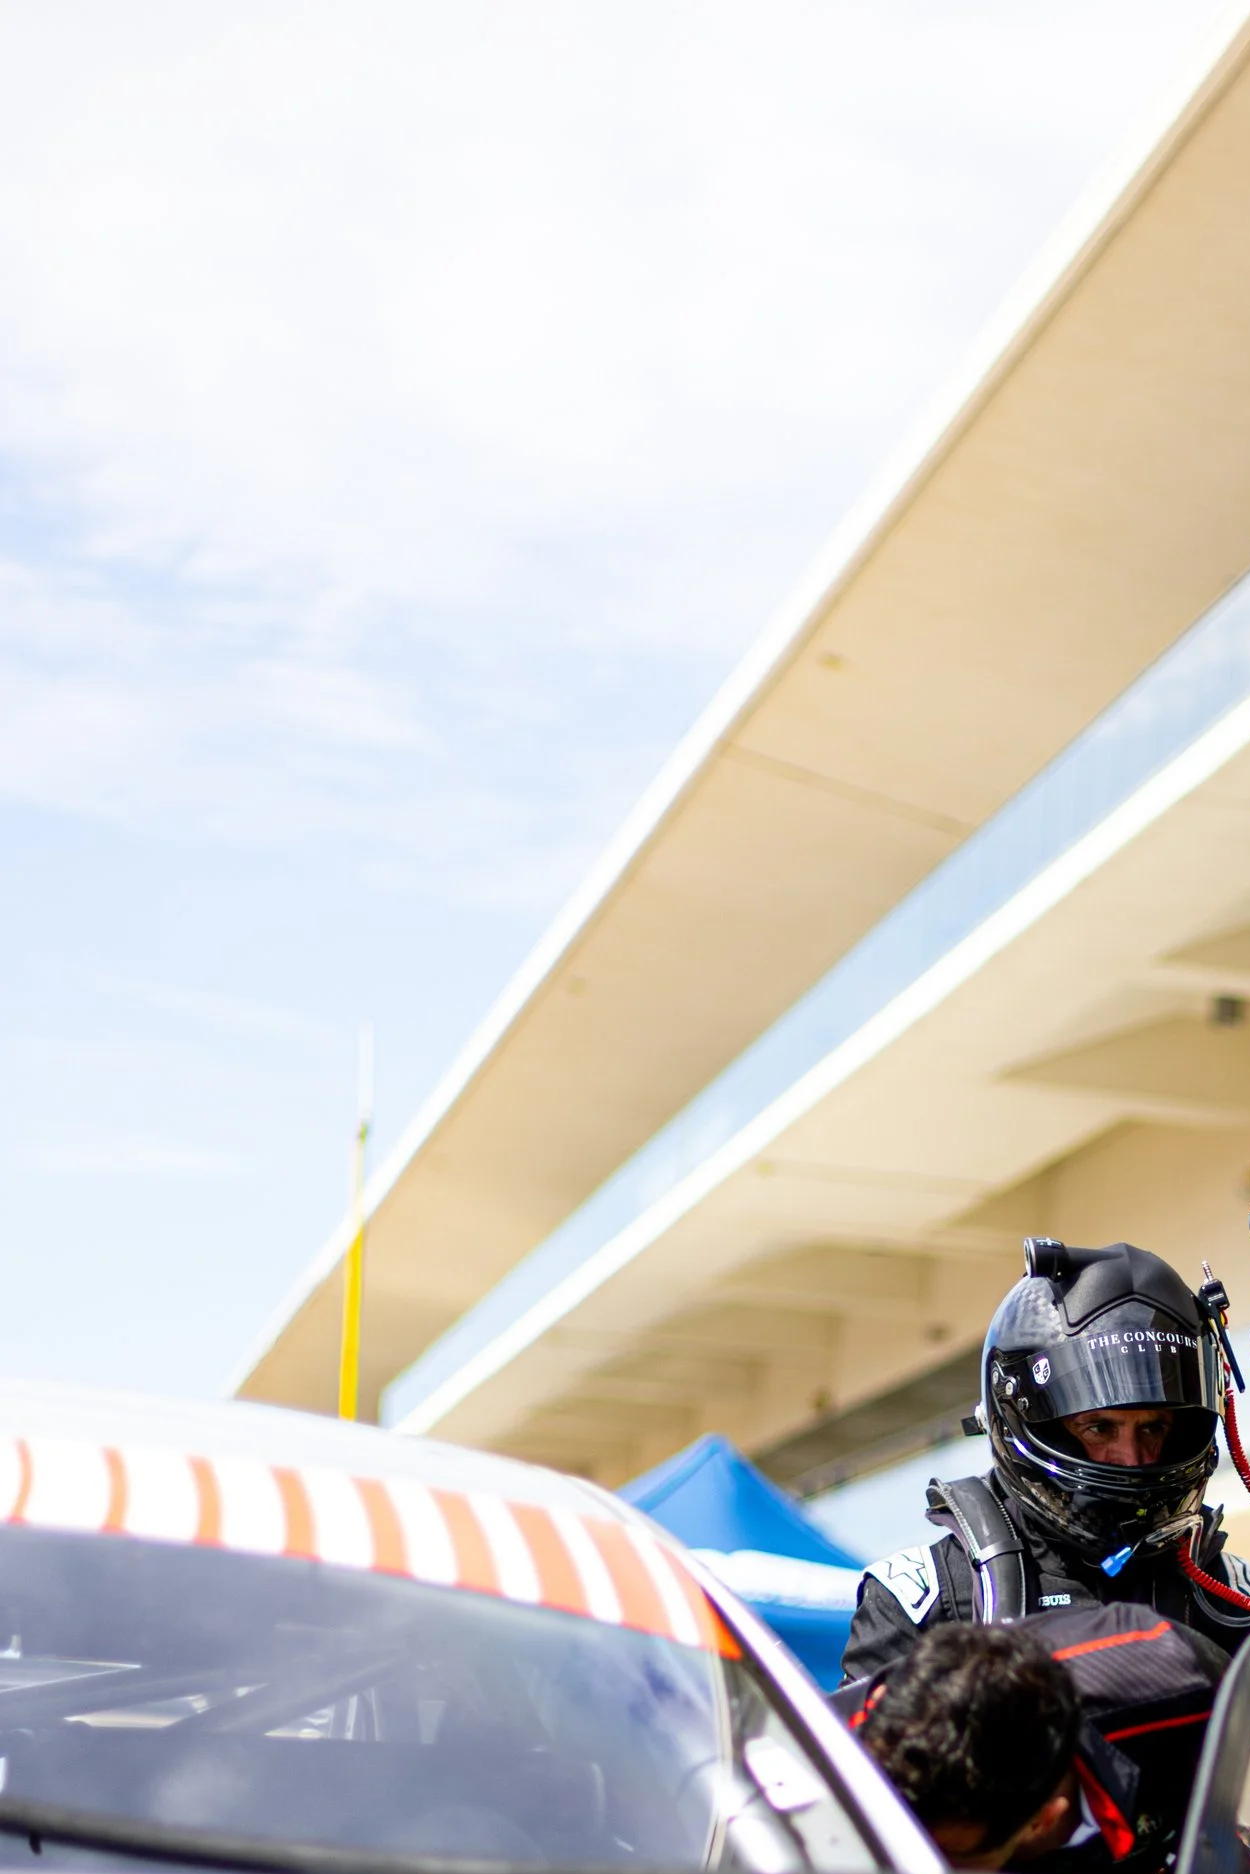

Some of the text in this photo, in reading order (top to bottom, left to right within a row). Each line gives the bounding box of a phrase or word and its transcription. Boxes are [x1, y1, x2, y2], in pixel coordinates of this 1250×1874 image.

[1087, 1330, 1199, 1350] THE CONCOURS
[1120, 1344, 1178, 1354] CLUB
[1038, 1593, 1072, 1607] BUIS
